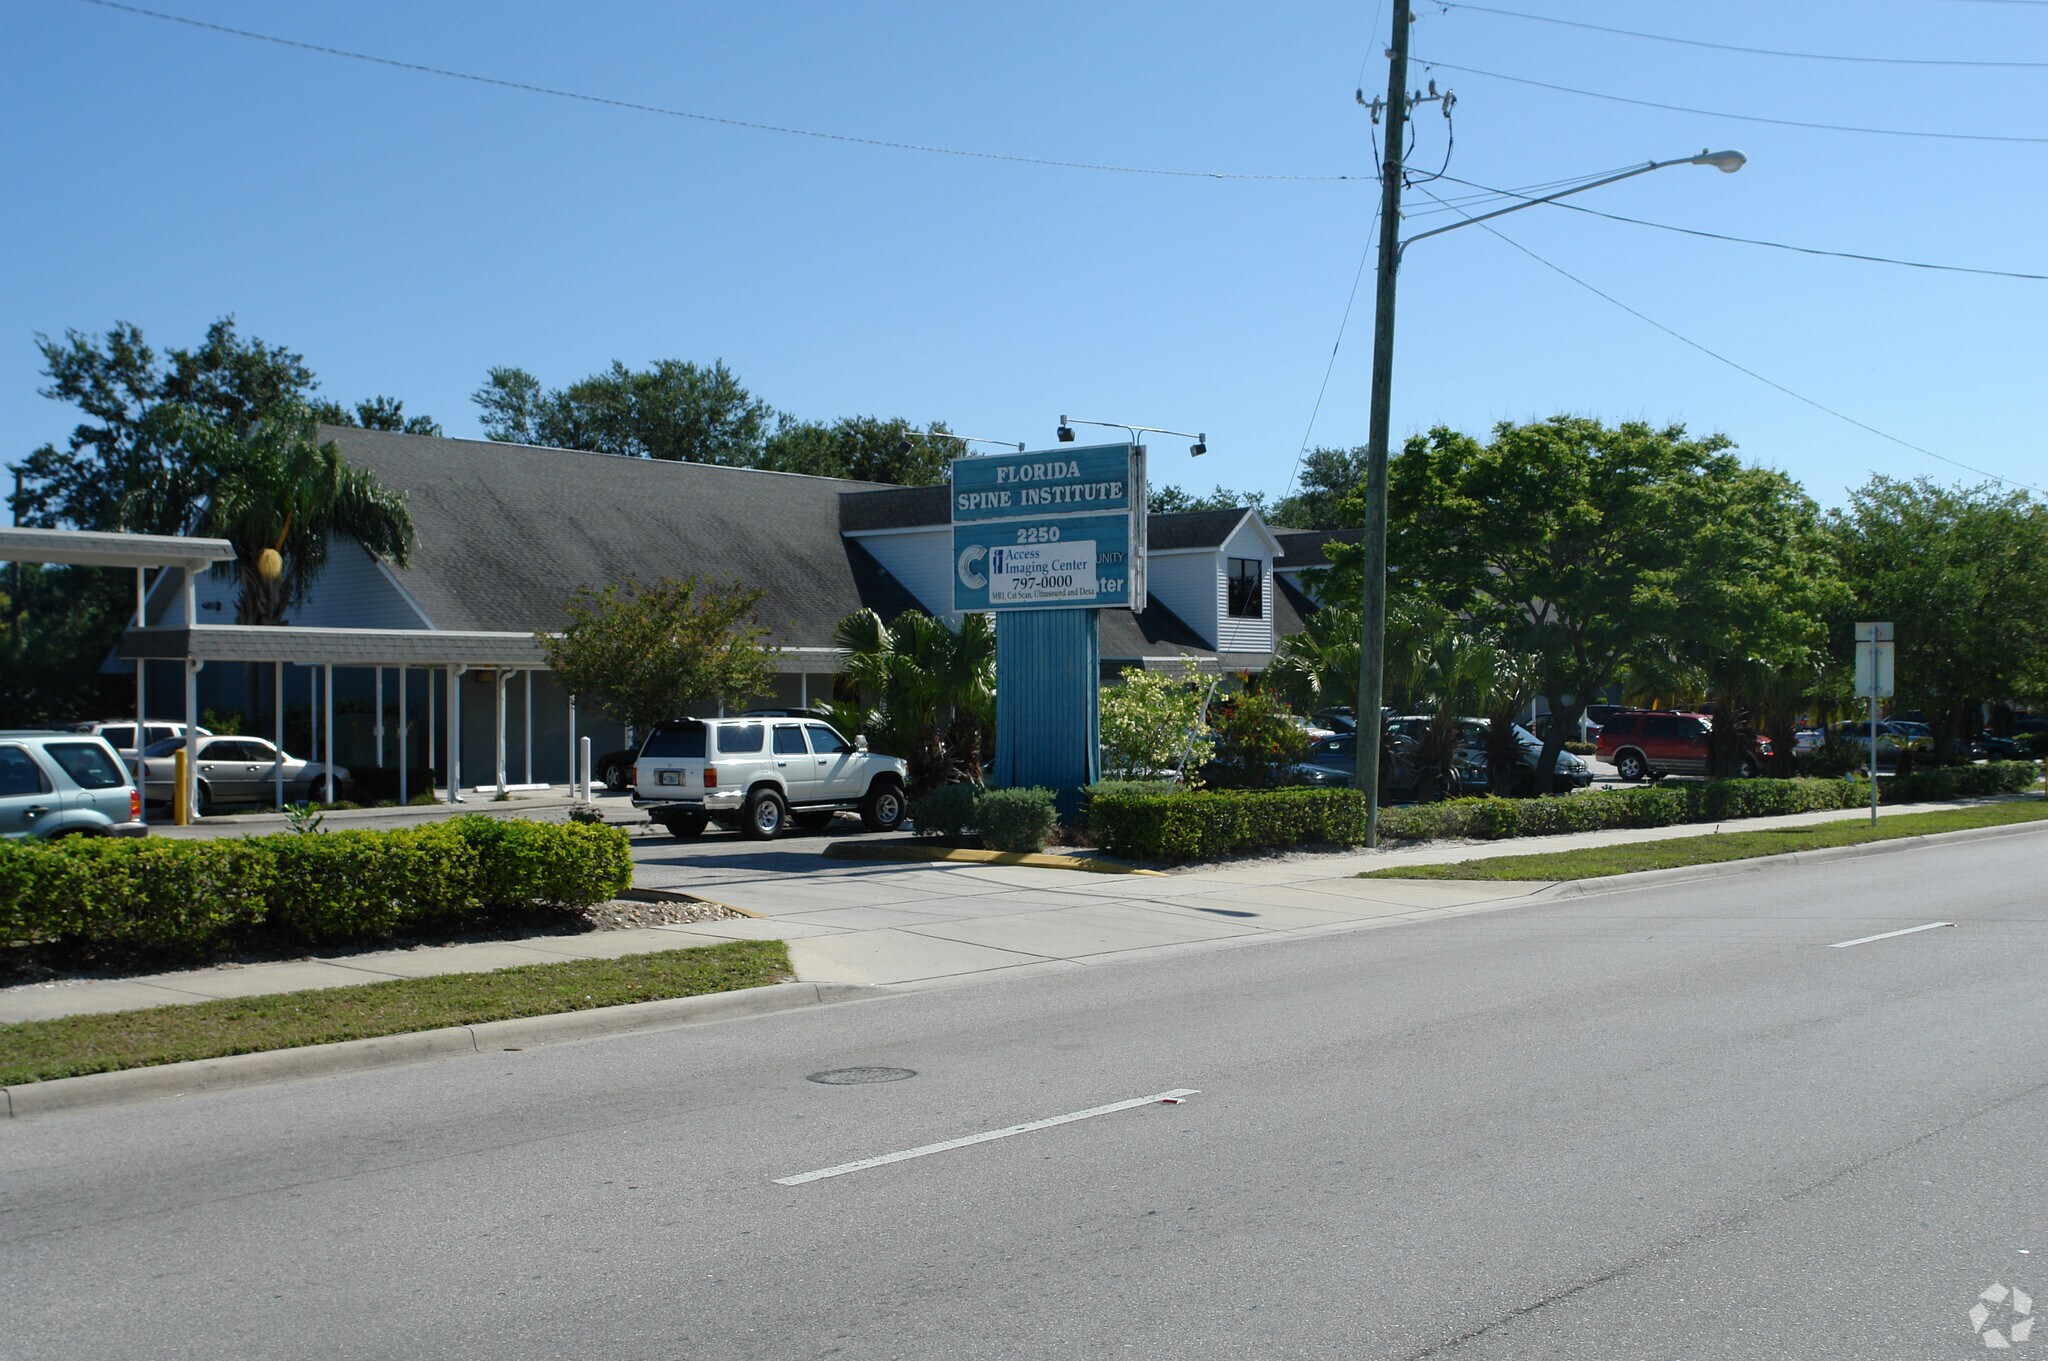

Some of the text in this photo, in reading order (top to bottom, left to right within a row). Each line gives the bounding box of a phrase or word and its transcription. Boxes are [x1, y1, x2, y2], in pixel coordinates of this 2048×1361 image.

[996, 461, 1081, 484] FLORIDA
[958, 481, 1123, 511] SPINE INSTITUTE
[1017, 526, 1060, 544] 2250
[1005, 549, 1040, 560] Access
[1005, 559, 1088, 576] Imaging Center
[1012, 575, 1073, 590] 797-0000
[1007, 591, 1018, 600] Cat
[1034, 588, 1066, 598] Ultrasound
[1067, 587, 1078, 597] and
